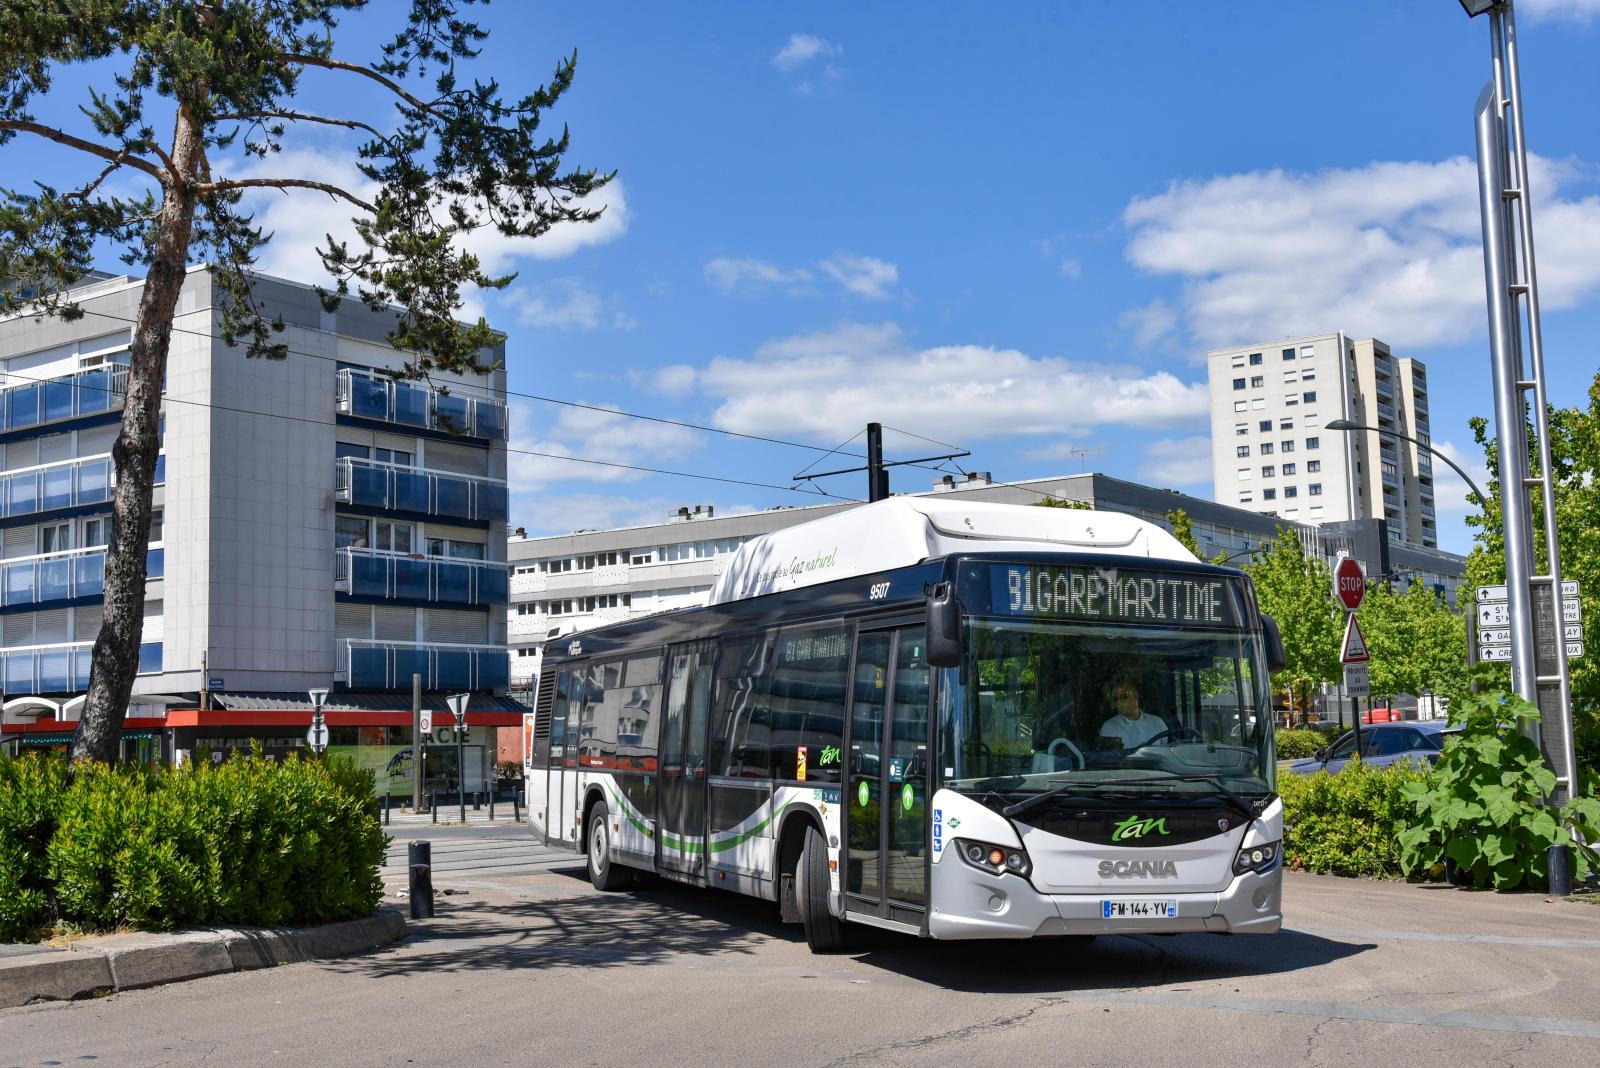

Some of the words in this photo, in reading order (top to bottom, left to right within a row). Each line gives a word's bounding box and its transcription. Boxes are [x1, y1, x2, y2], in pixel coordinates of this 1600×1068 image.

[805, 547, 837, 572] naturel
[870, 582, 890, 600] 9507
[1340, 576, 1361, 592] STOP
[1037, 571, 1100, 615] GARE
[1107, 576, 1222, 622] MARITIME
[819, 745, 841, 766] tan
[1112, 815, 1171, 842] tan
[1097, 860, 1178, 879] SCANIA
